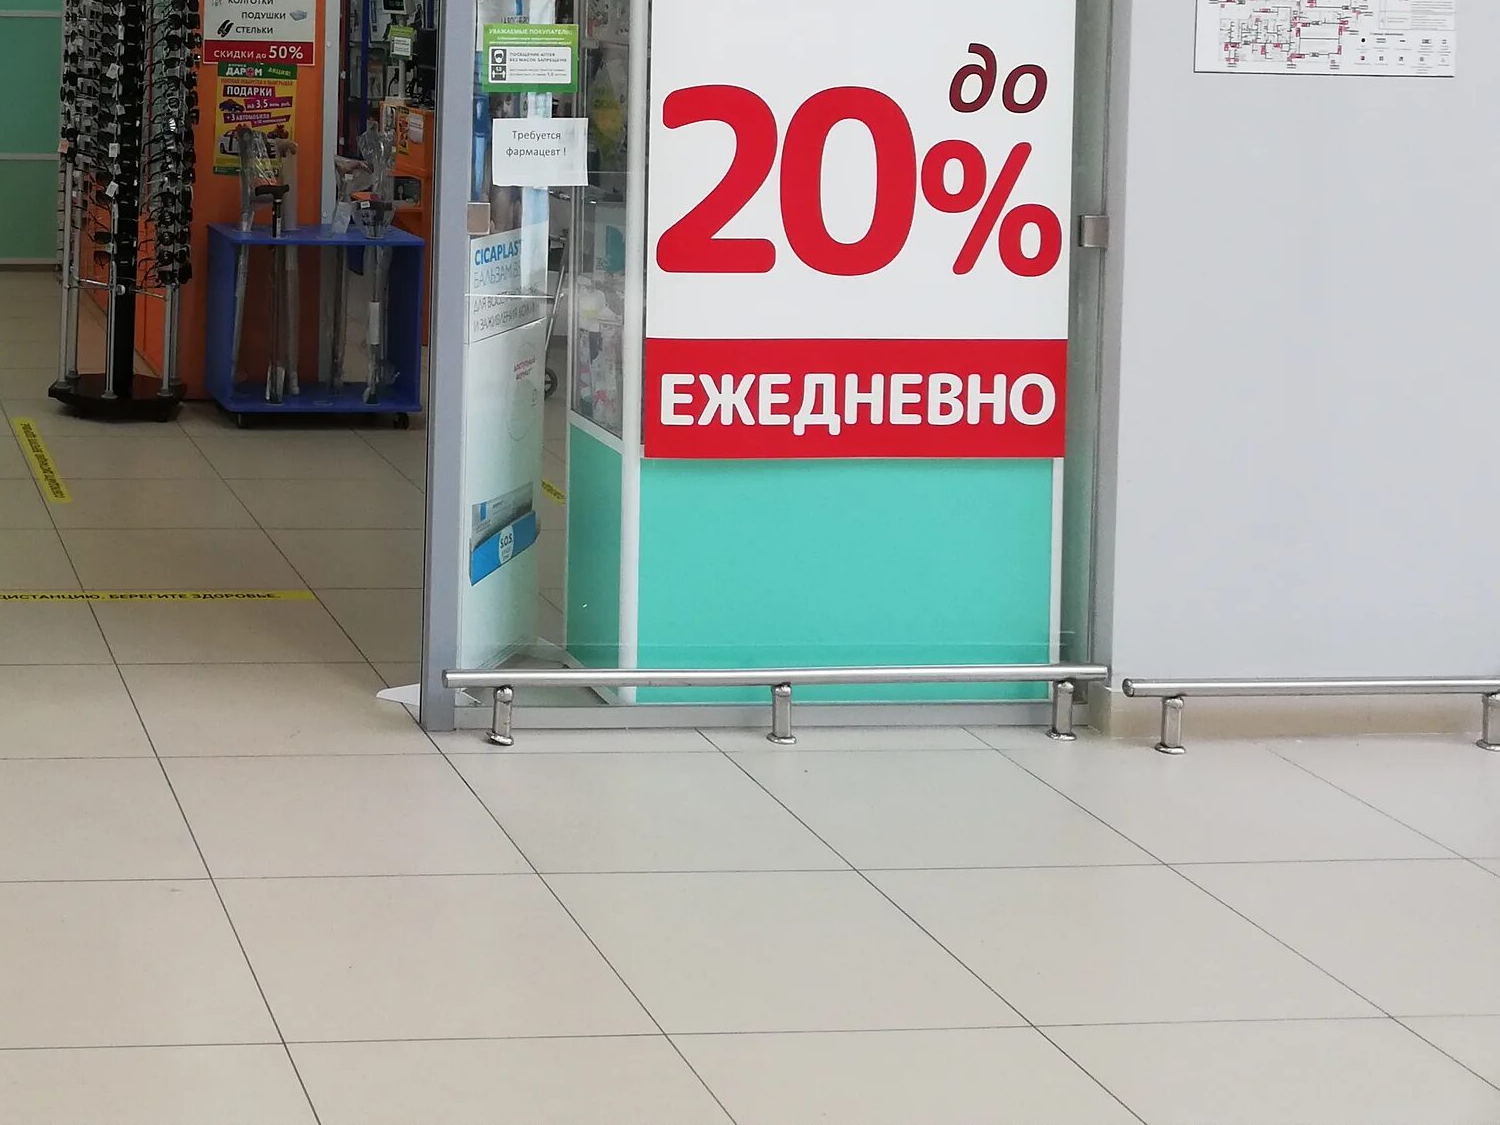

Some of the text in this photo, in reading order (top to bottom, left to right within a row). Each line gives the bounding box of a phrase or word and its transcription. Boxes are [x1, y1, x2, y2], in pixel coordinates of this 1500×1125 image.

[241, 12, 286, 20] ПОДУШКИ
[214, 50, 254, 58] СКИДКИ
[269, 45, 304, 59] 50%
[949, 43, 1048, 114] до
[227, 86, 272, 97] ПОДАРКИ
[512, 131, 561, 143] Требуется
[506, 147, 560, 159] фармацевт
[656, 84, 1062, 277] 20%
[660, 372, 1056, 436] ЕЖЕДНЕВНО
